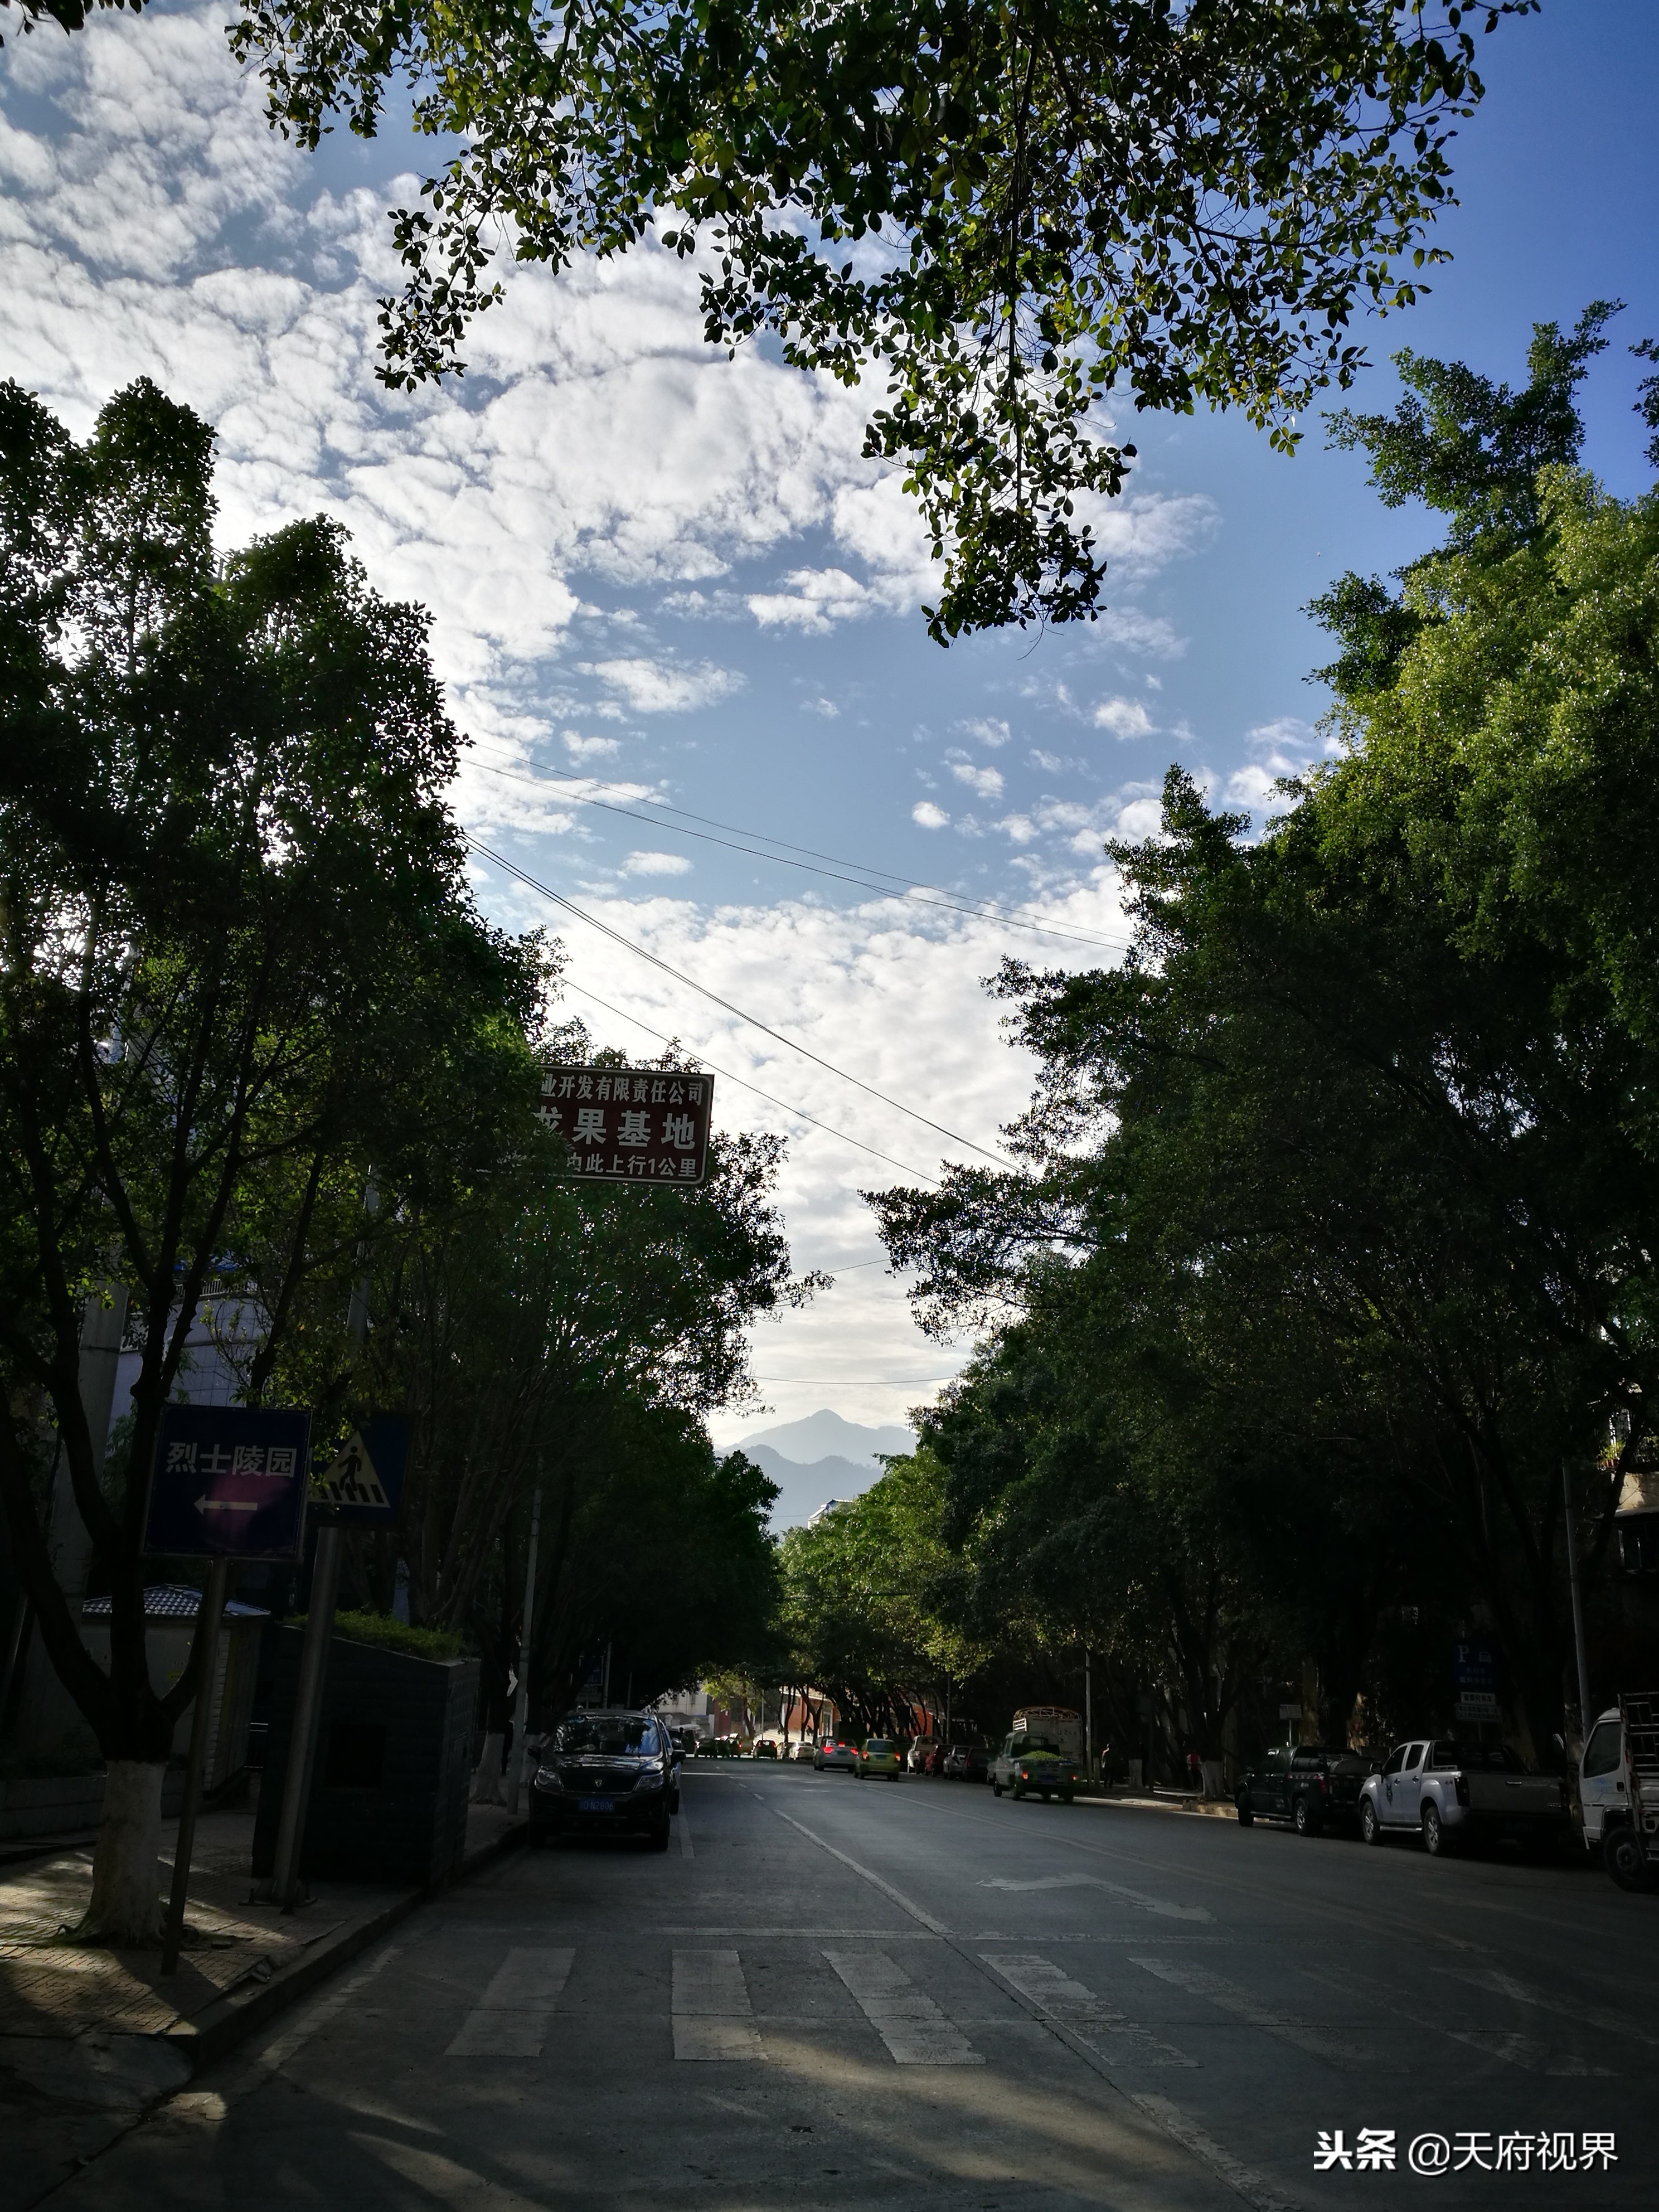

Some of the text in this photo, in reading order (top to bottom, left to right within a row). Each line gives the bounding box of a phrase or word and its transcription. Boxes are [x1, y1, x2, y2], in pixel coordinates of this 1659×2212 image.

[165, 1442, 297, 1478] 烈士陵园
[1457, 1645, 1469, 1662] P
